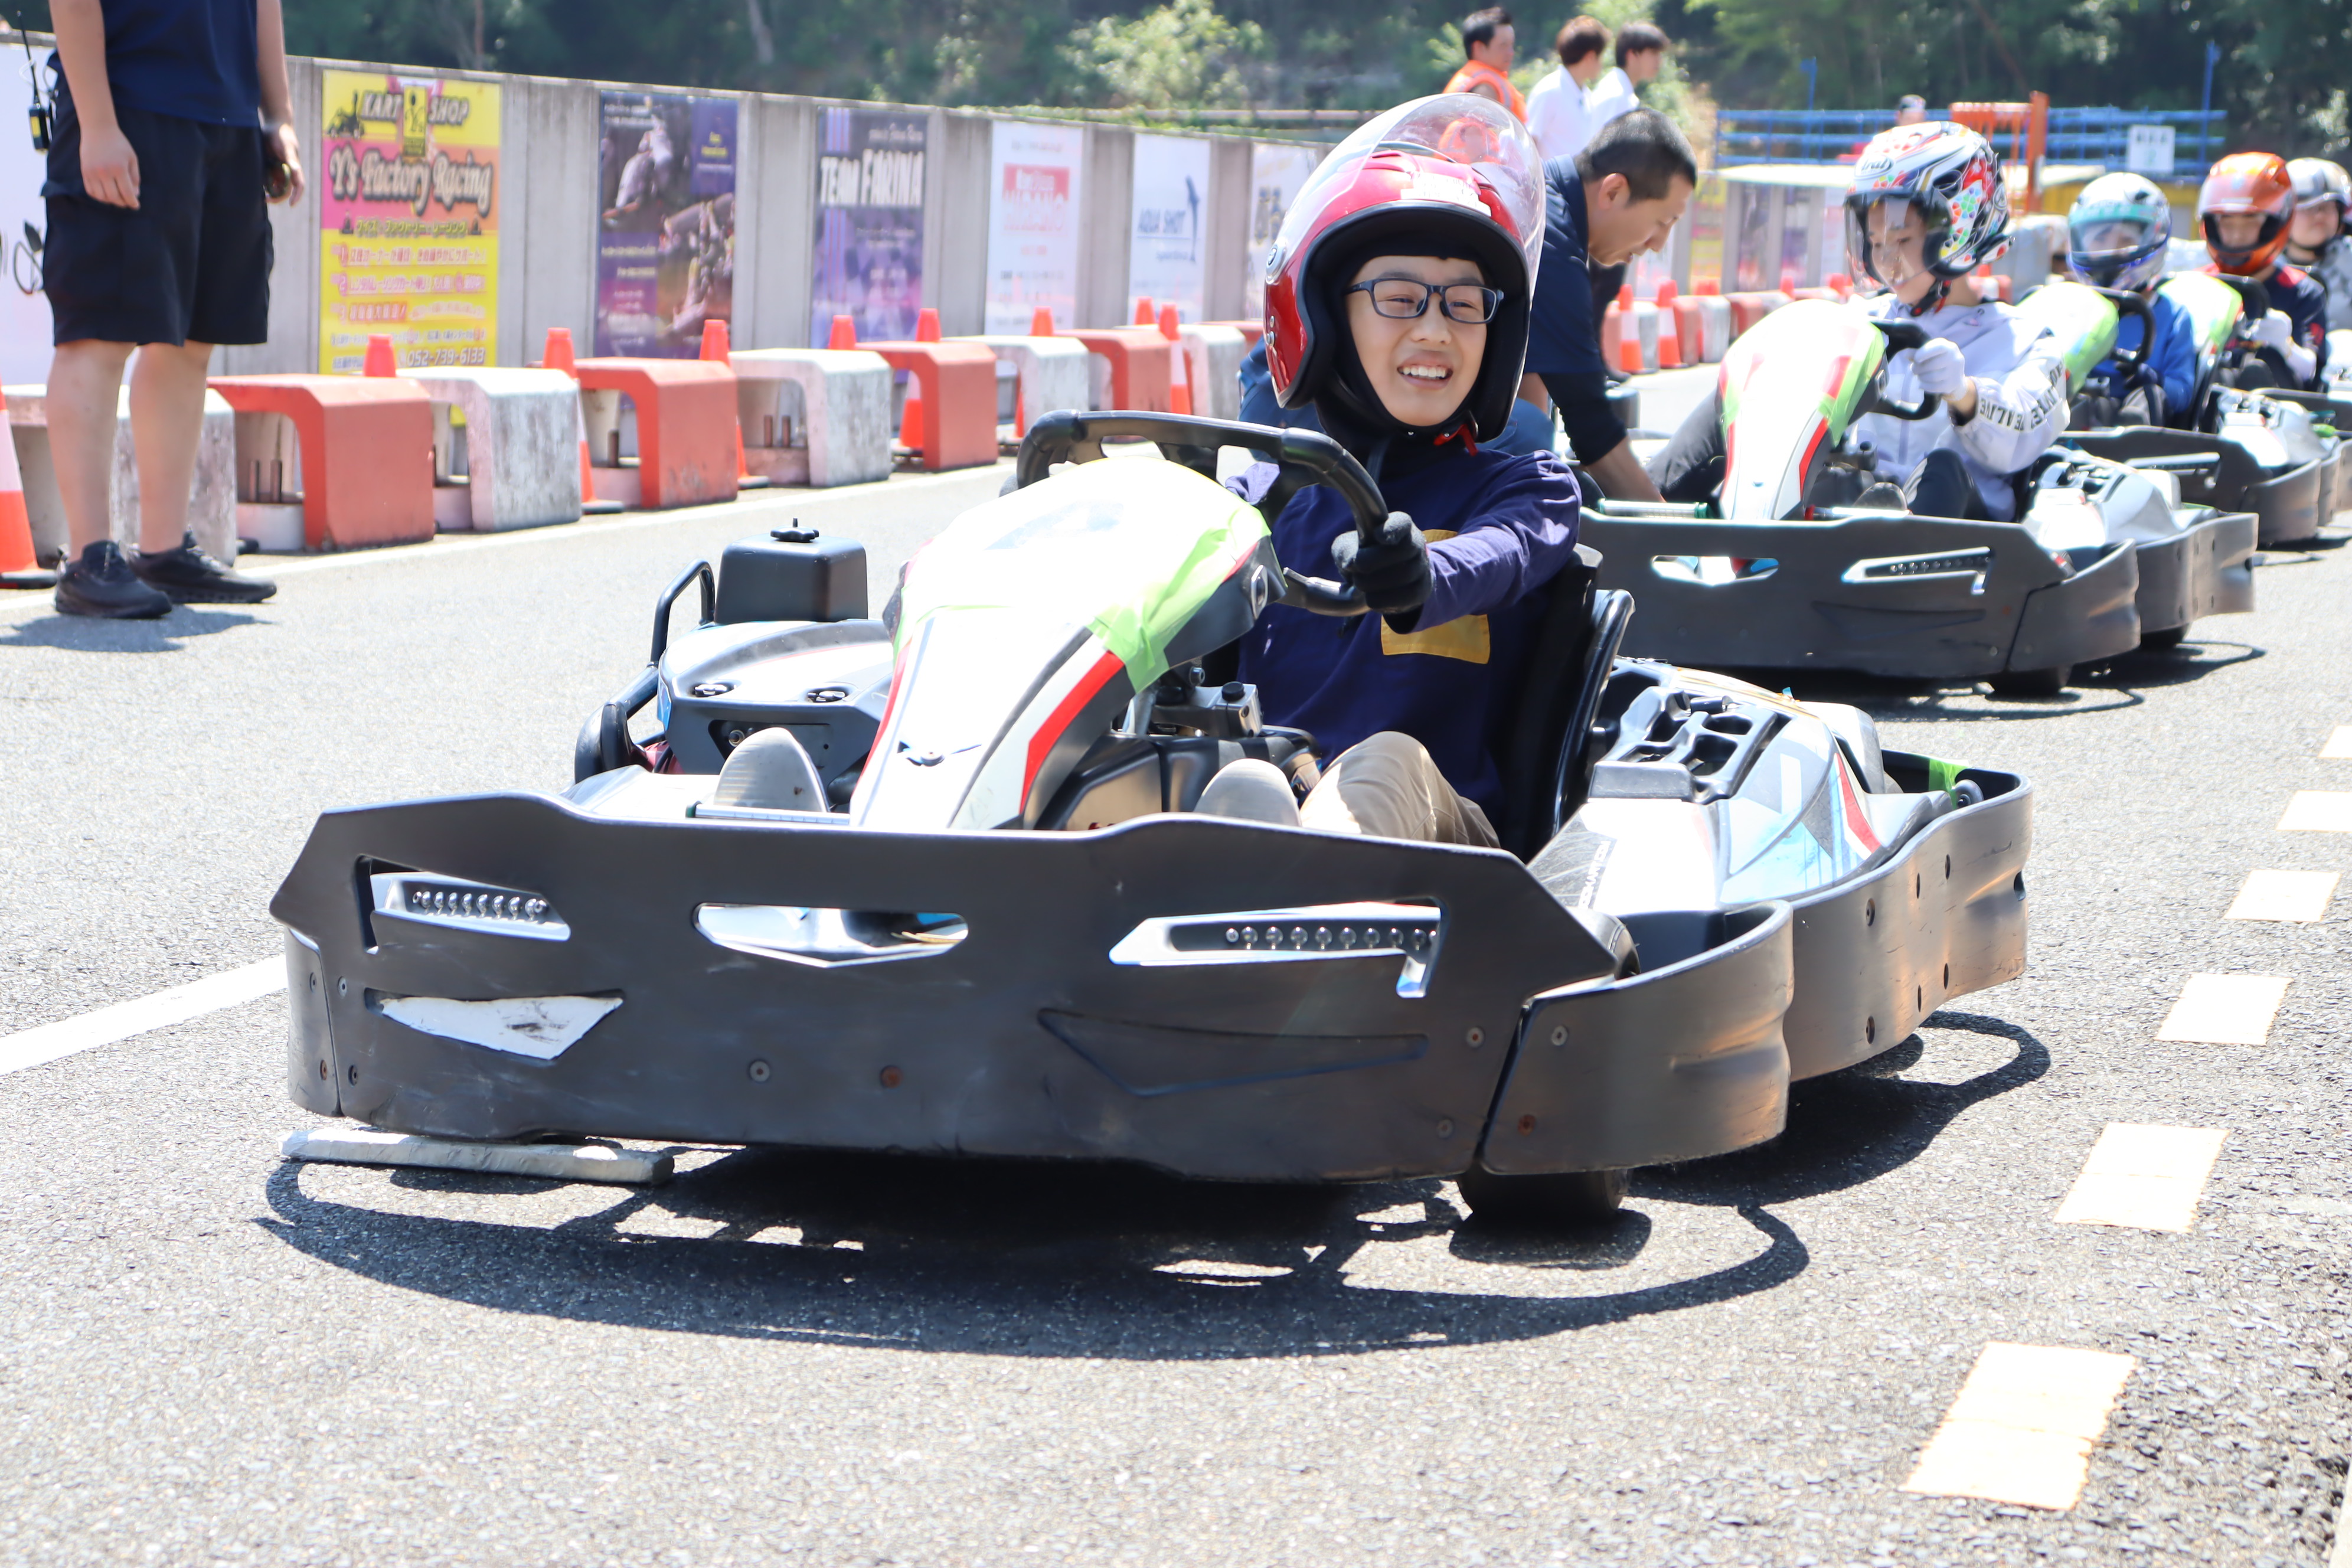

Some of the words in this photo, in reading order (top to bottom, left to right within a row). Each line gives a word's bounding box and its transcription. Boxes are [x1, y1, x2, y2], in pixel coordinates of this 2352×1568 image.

[360, 91, 403, 122] KART
[428, 96, 469, 126] SHOP
[329, 142, 358, 201] Y's
[361, 148, 430, 216] Factory
[432, 150, 493, 218] Racing
[820, 156, 860, 206] TEAM
[407, 347, 486, 367] 052-739-6133
